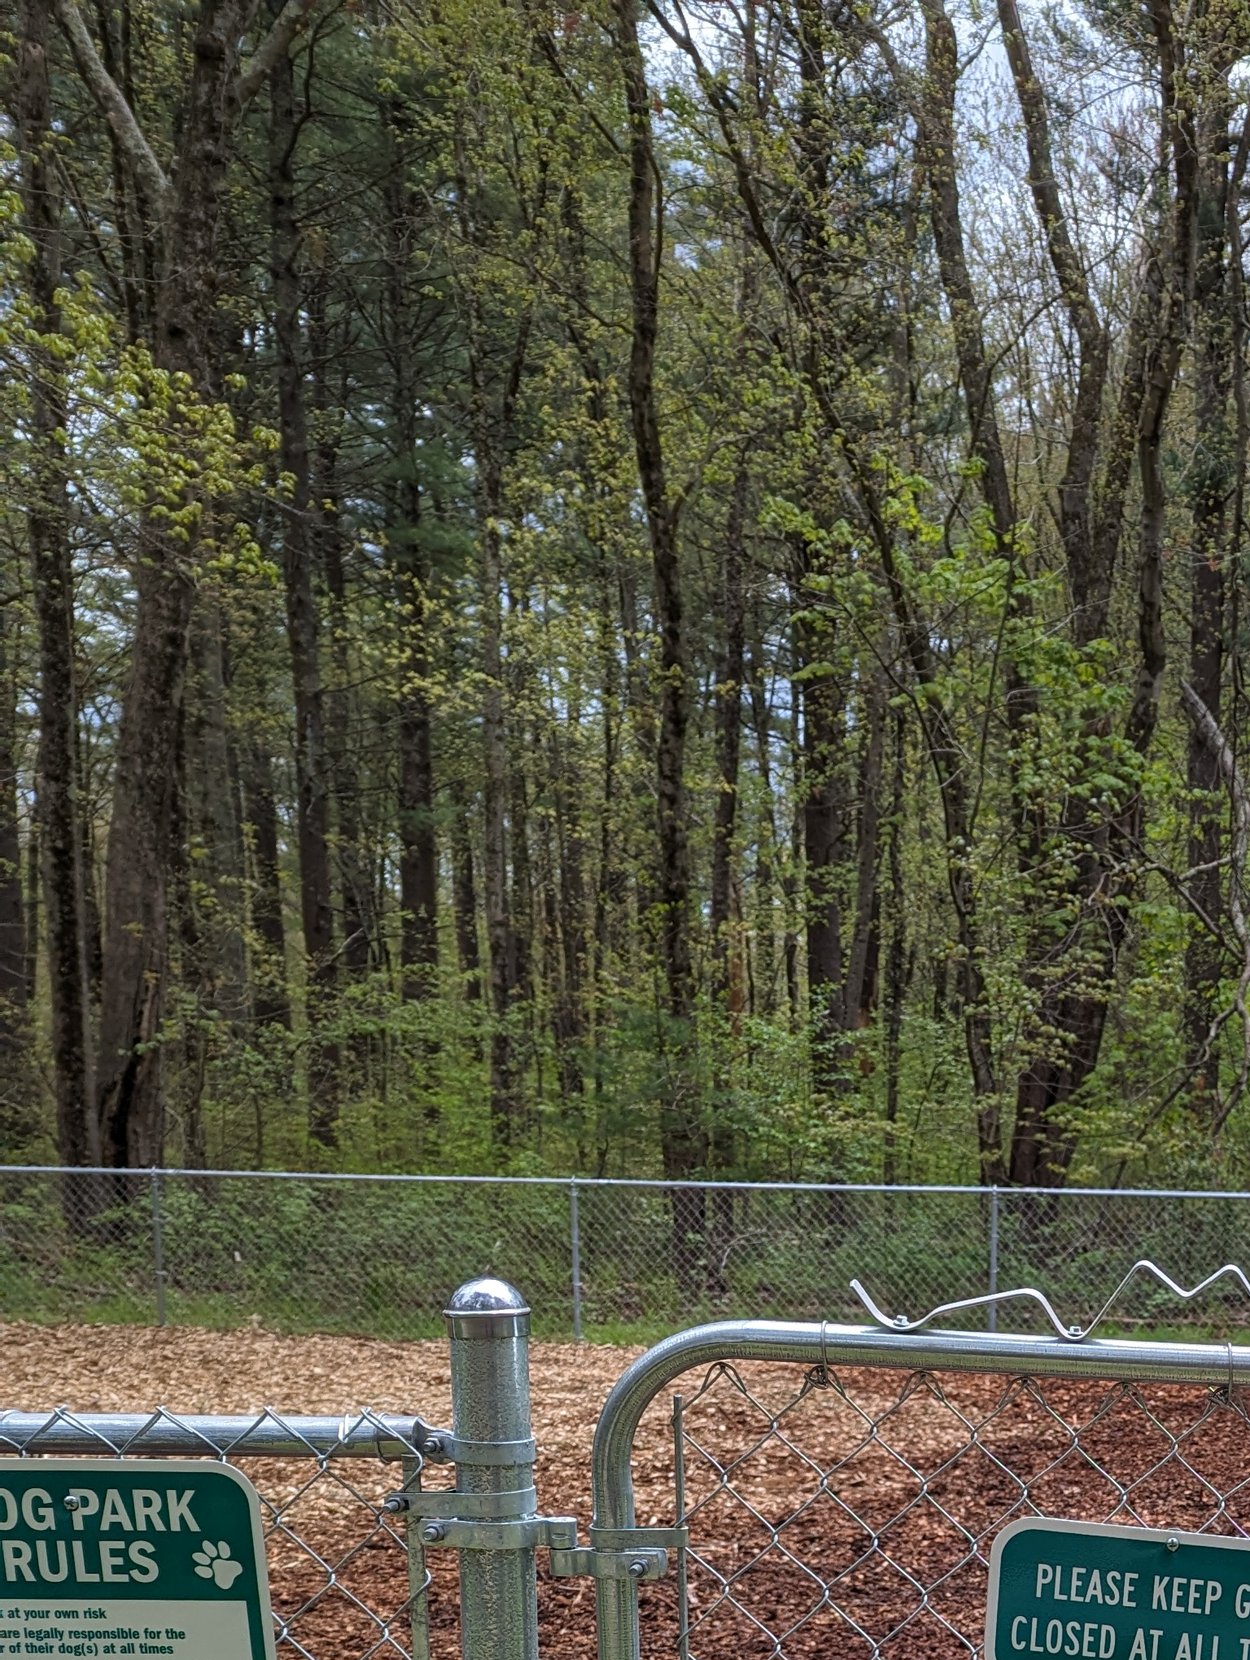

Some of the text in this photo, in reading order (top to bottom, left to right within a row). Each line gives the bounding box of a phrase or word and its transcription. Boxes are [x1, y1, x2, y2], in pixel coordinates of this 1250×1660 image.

[68, 1488, 201, 1532] PARK
[1, 1540, 160, 1583] RULES
[1035, 1564, 1139, 1608] PLEASE
[1152, 1575, 1222, 1615] KEEP
[0, 1627, 185, 1641] are legally responsible for the
[8, 1608, 21, 1618] at
[24, 1610, 50, 1621] your
[54, 1610, 79, 1619] own
[84, 1608, 107, 1619] risk
[9, 1642, 21, 1653] of
[25, 1642, 54, 1653] their
[58, 1643, 98, 1656] dog(s)
[103, 1643, 116, 1654] at
[120, 1643, 135, 1654] all
[139, 1643, 173, 1654] times
[1011, 1615, 1116, 1659] CLOSED
